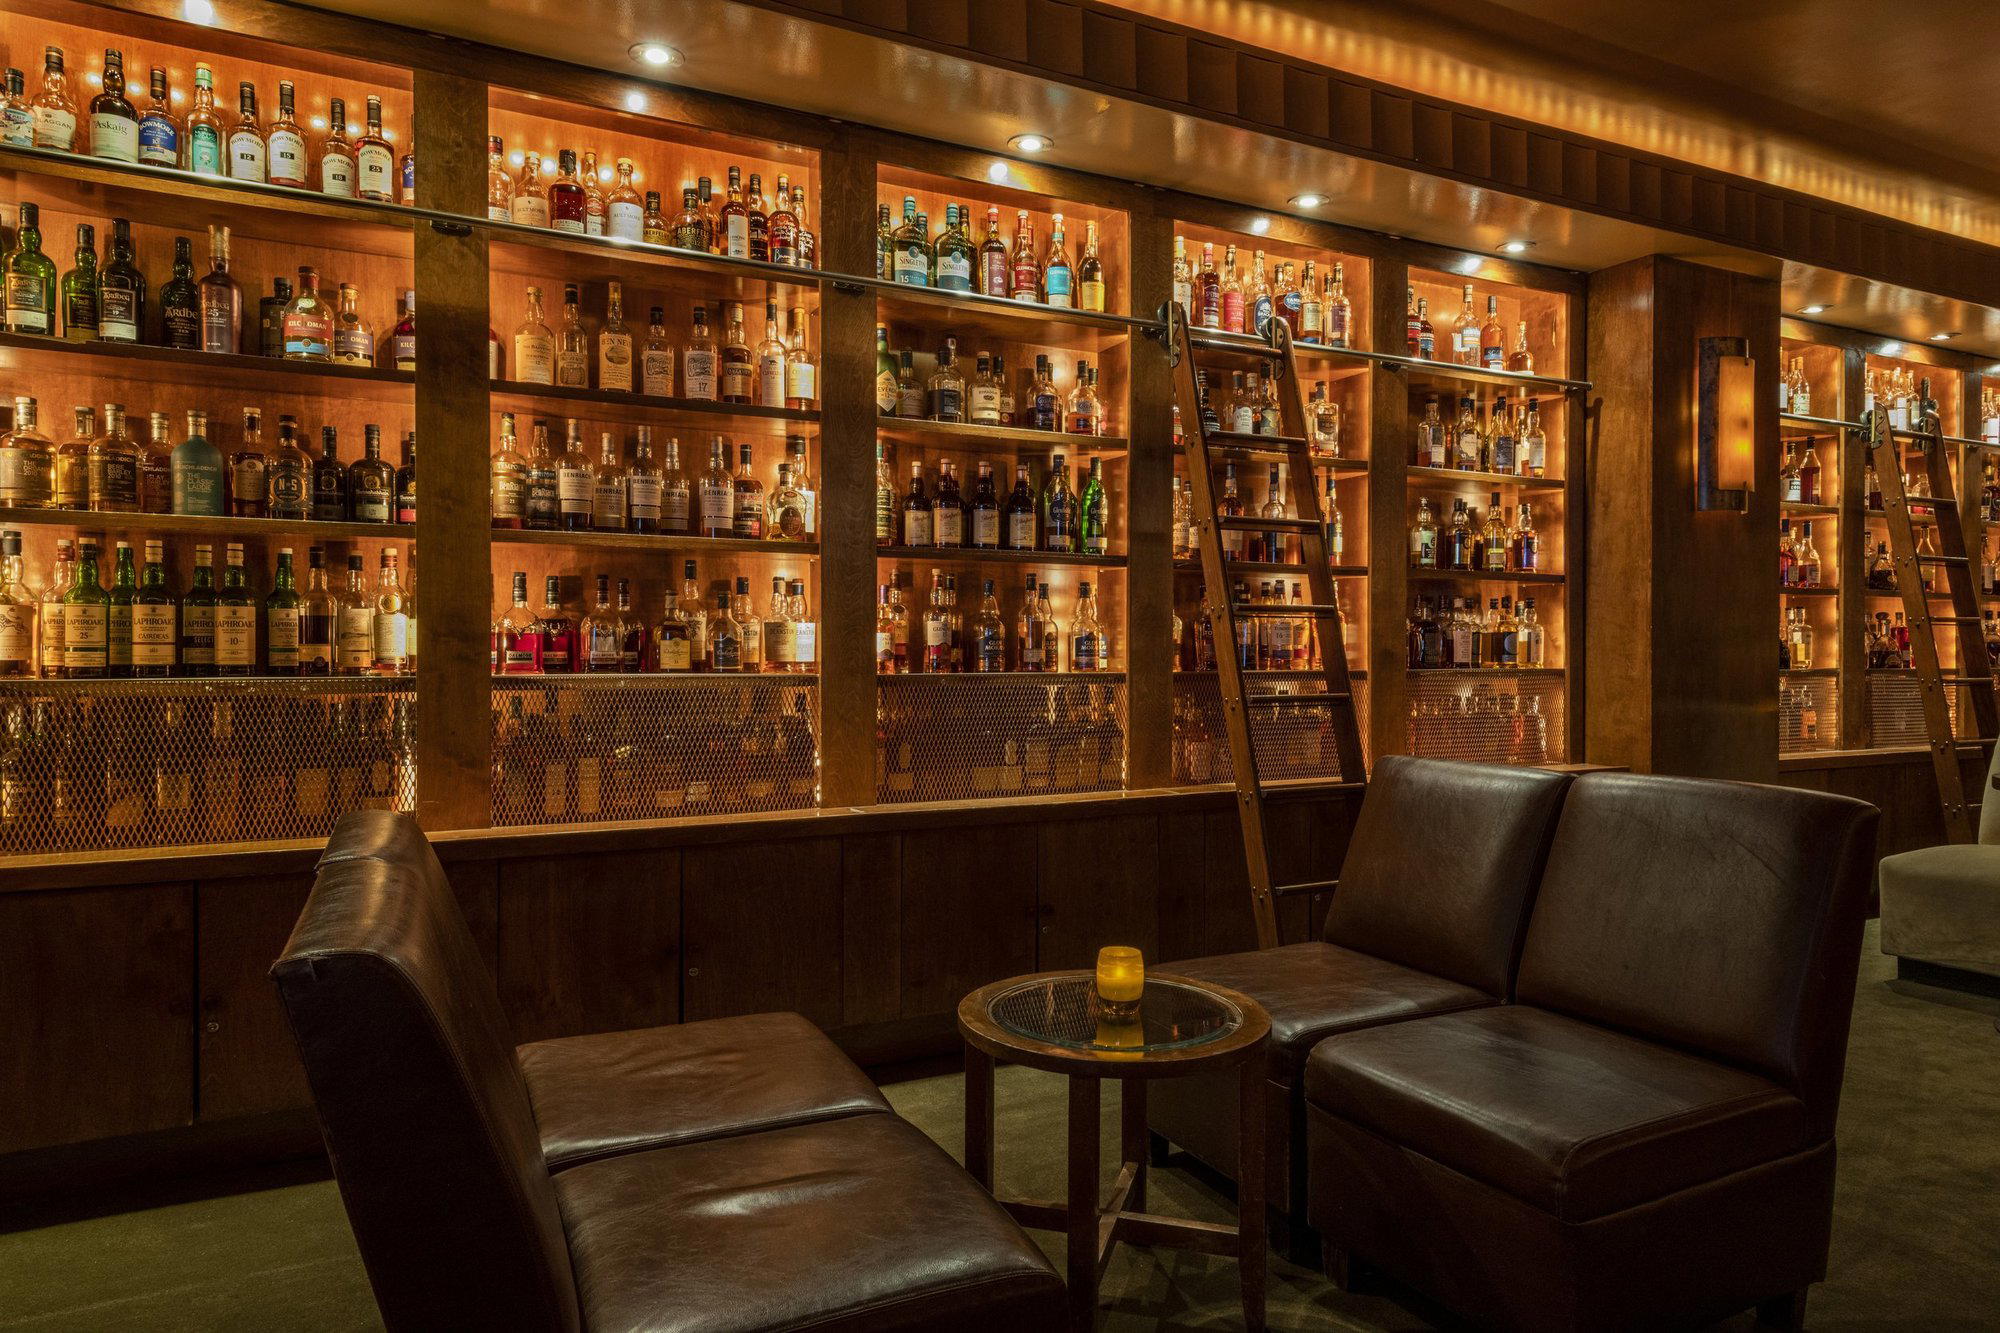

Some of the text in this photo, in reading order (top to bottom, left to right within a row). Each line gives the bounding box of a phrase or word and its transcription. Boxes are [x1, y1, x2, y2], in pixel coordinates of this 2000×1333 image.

[231, 136, 264, 150] BOWMORE
[271, 135, 304, 149] BOWMORE
[360, 149, 391, 162] BOWMORE
[322, 157, 355, 170] BOWMORE
[900, 275, 910, 283] 15
[698, 381, 708, 393] 17
[67, 618, 104, 627] LAPHROAIG
[133, 616, 174, 626] LAPHROAIG
[184, 620, 215, 628] LAPHRO
[216, 619, 255, 628] LAPHROAIG
[79, 632, 89, 640] 25
[229, 636, 240, 646] 10
